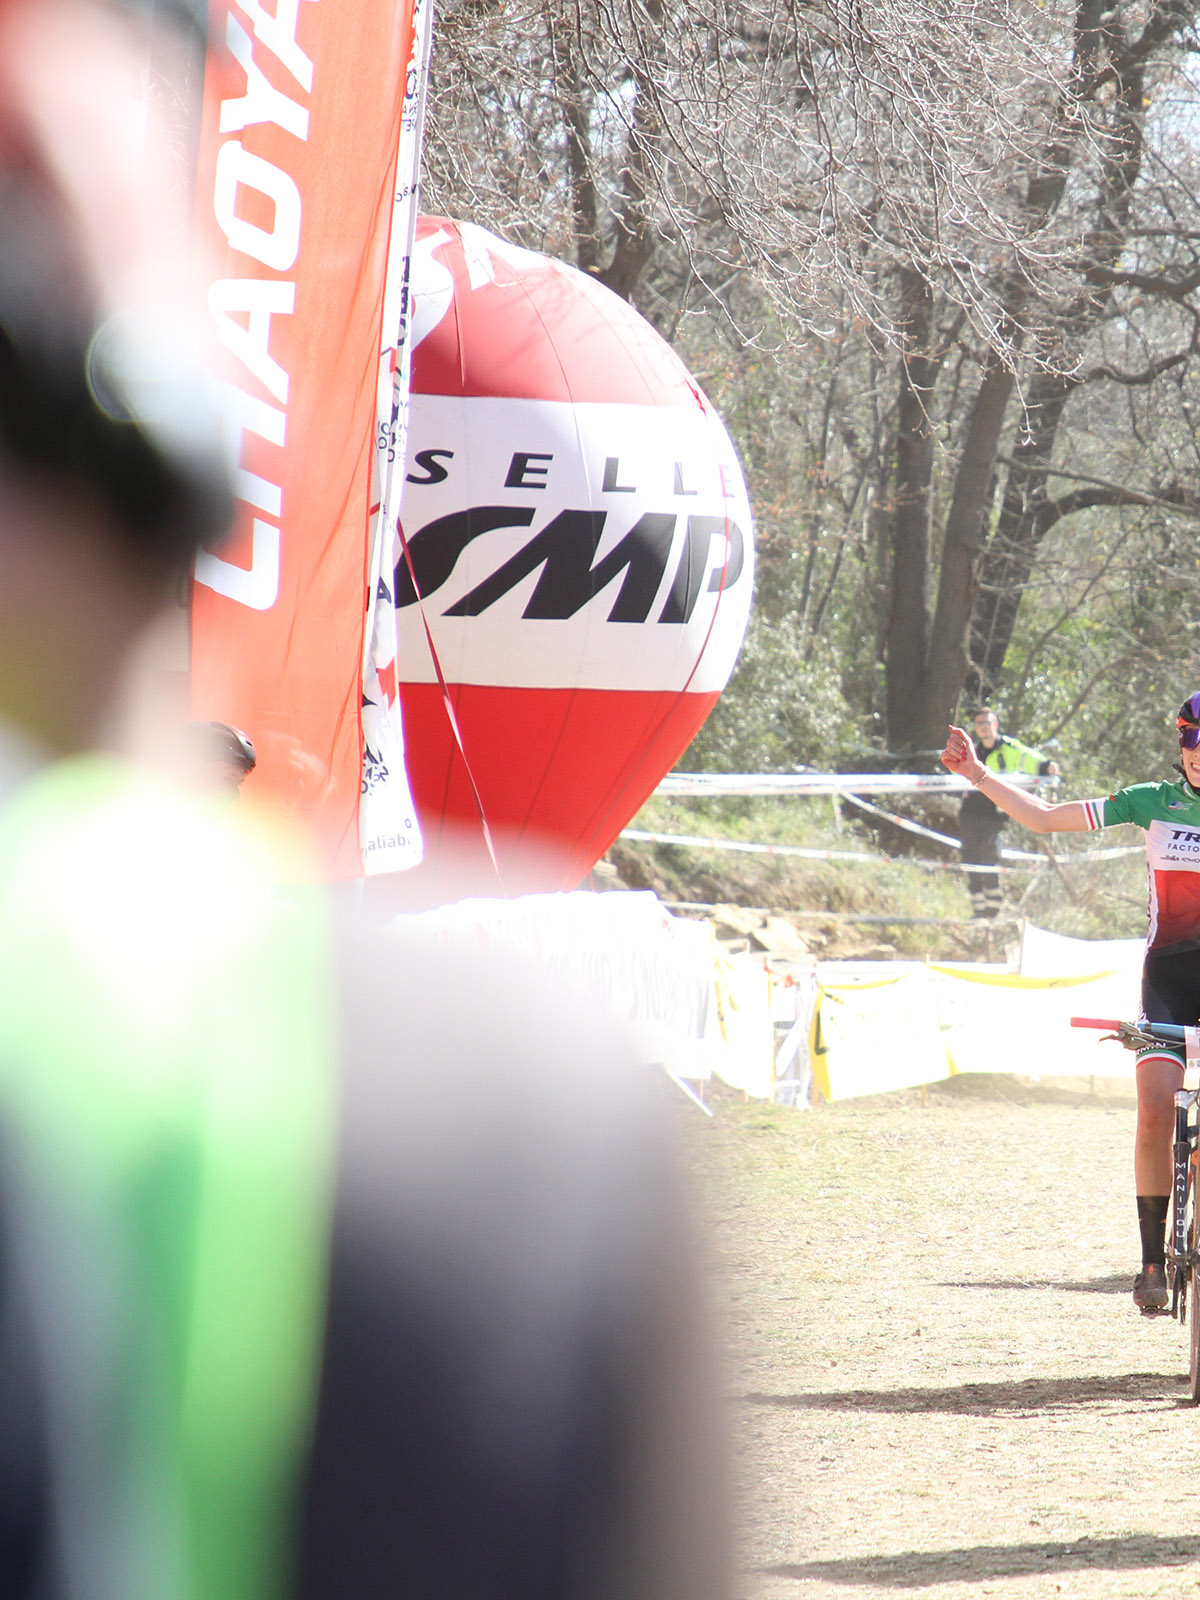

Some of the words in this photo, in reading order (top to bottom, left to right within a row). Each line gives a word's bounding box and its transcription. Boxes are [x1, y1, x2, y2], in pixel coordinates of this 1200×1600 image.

[405, 449, 736, 499] SELLE
[394, 505, 745, 624] SMP
[1175, 1162, 1186, 1238] MANITOU
